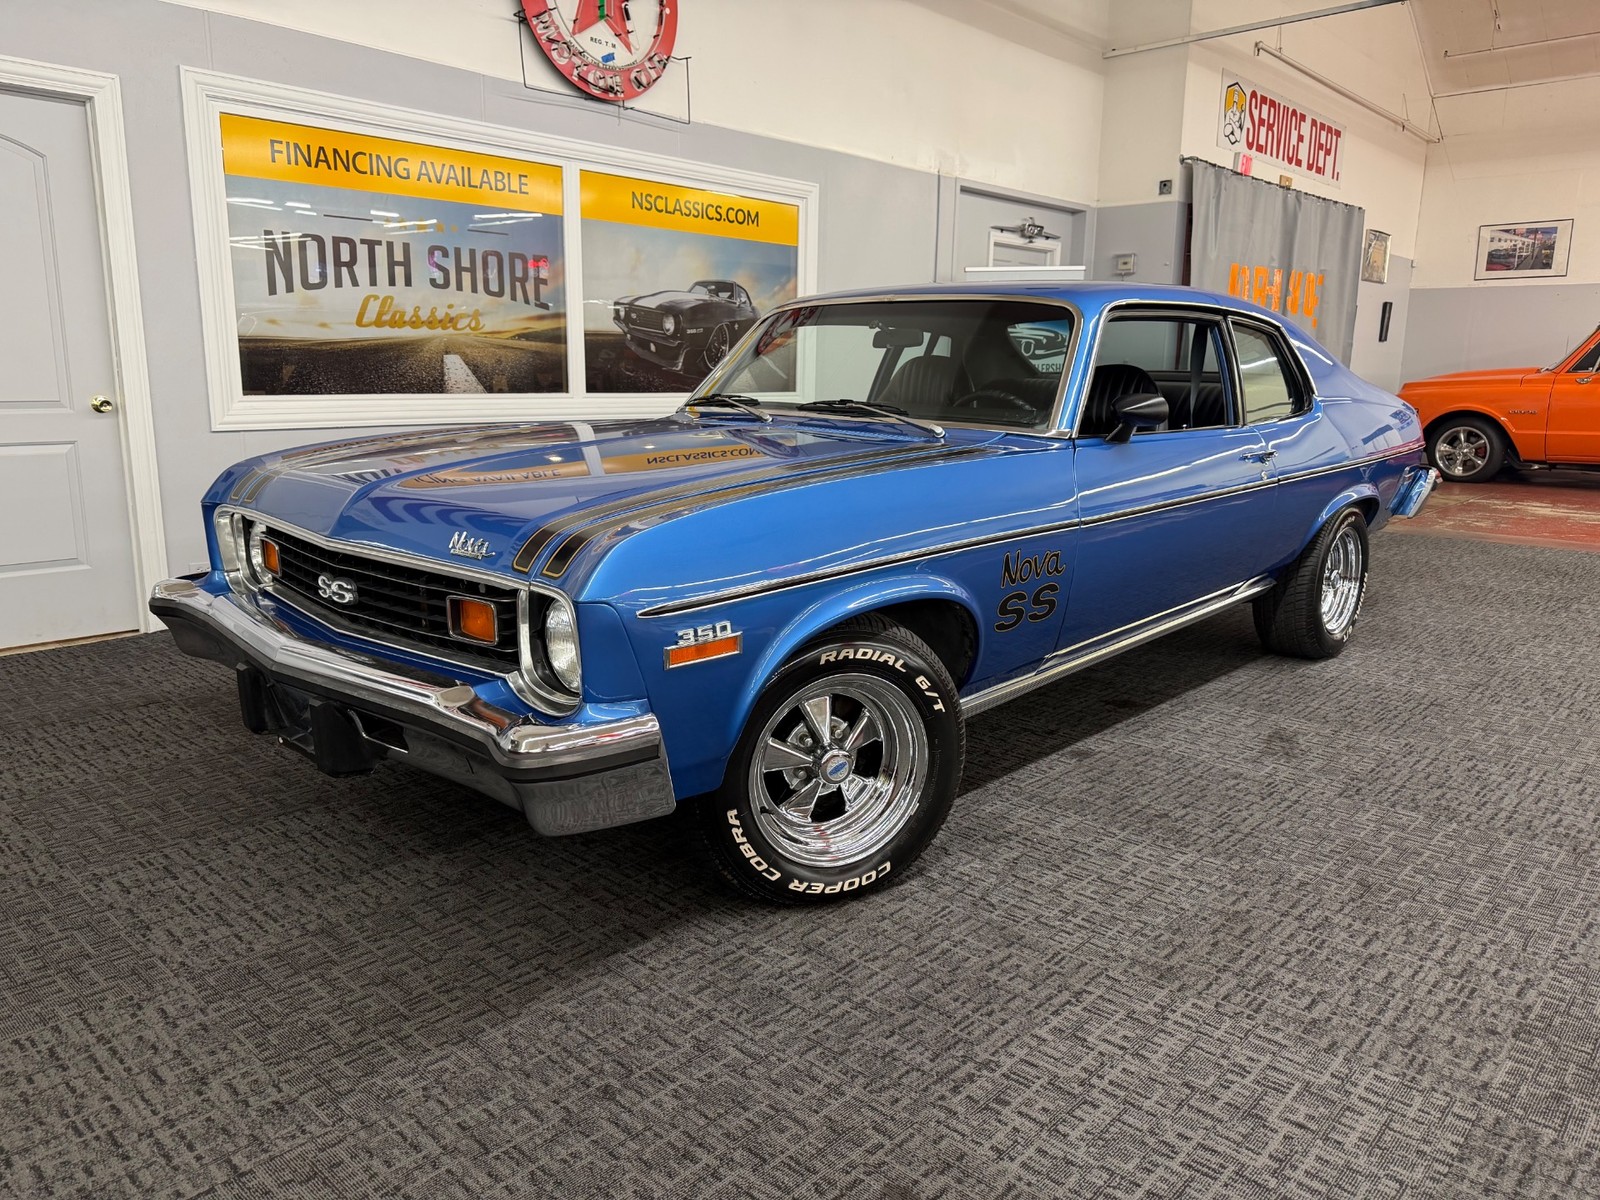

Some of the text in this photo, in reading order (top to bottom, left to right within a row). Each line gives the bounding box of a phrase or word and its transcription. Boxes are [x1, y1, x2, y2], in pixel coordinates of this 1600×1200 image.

[532, 10, 625, 97] MOTOR
[1246, 90, 1342, 181] SERVICE DEPT.
[269, 138, 530, 195] FINANCING AVAILABLE
[631, 191, 760, 227] NSCLASSICS.COM
[263, 229, 551, 311] NORTH SHORE
[355, 294, 486, 332] Classics
[449, 531, 496, 560] Nova
[1001, 549, 1066, 589] Nova
[317, 573, 357, 605] SS
[994, 582, 1060, 632] SS
[677, 620, 732, 646] 350
[819, 648, 946, 713] RADIAL G/T
[727, 808, 891, 895] COOPER COBRA
